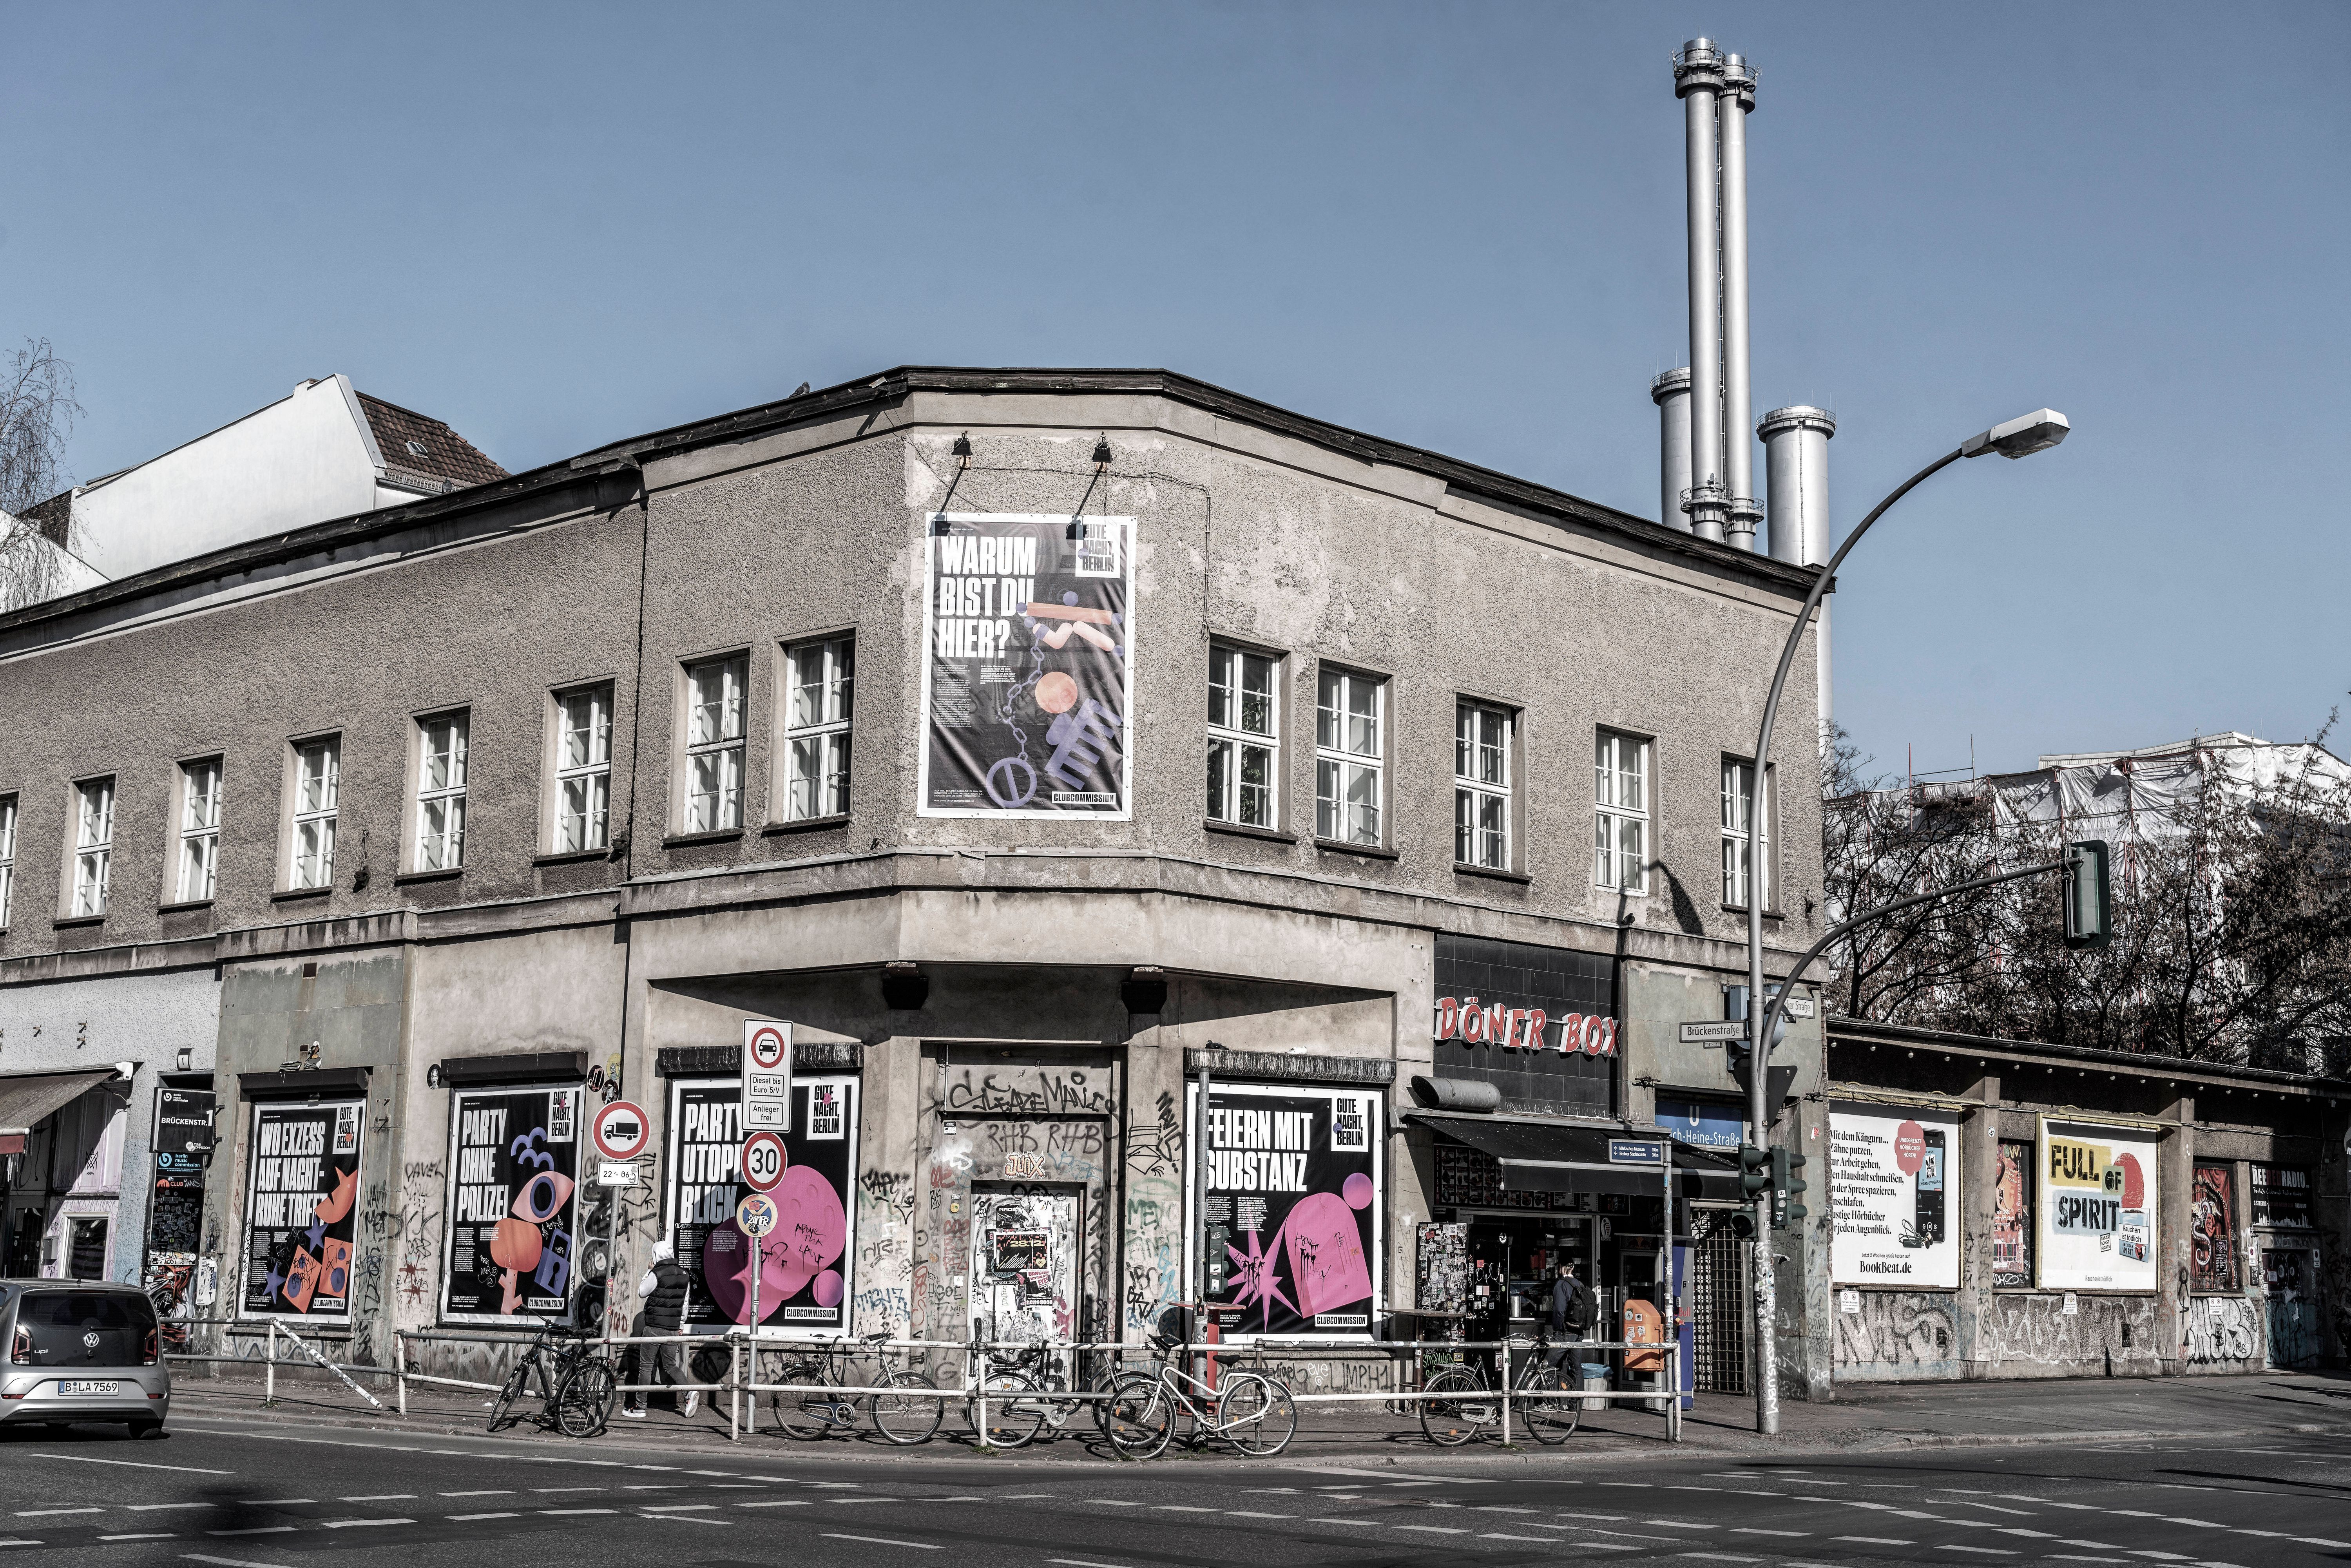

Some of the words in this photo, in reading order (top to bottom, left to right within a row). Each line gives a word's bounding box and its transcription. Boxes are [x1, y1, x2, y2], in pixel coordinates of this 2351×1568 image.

[1084, 524, 1106, 539] GUTE
[940, 536, 1036, 575] WARUM
[1083, 540, 1114, 557] NACHT,
[1082, 556, 1114, 572] BERLIN
[940, 577, 996, 616] BIST
[1001, 578, 1034, 617] DU
[938, 619, 1010, 658] HIER?
[1053, 793, 1114, 803] CLUBCOMMISSION
[1795, 1001, 1810, 1014] Straße
[1435, 996, 1546, 1050] DÖNER
[1559, 1013, 1623, 1057] BOX
[1687, 1024, 1740, 1036] Brückenstraße
[181, 1057, 184, 1065] 1
[553, 1091, 567, 1105] GUTE
[815, 1085, 834, 1100] GUTE
[340, 1107, 352, 1120] GUTE
[552, 1106, 570, 1121] NACHT,
[753, 1105, 779, 1113] Anlieger
[813, 1102, 839, 1117] NACHT,
[1337, 1098, 1356, 1114] GUTE
[161, 1117, 208, 1126] BRÜCKENSTR.
[206, 1110, 213, 1126] 1
[685, 1103, 743, 1141] PARTY
[1337, 1114, 1363, 1131] NACHT,
[1689, 1105, 1699, 1126] U
[338, 1121, 355, 1134] NACHT,
[462, 1109, 507, 1145] PARTY
[551, 1122, 570, 1136] BERLIN
[813, 1118, 839, 1133] BERLIN
[1275, 1111, 1313, 1151] MIT
[261, 1123, 281, 1155] WO
[281, 1121, 326, 1155] EXZESS
[1337, 1130, 1363, 1146] BERLIN
[1830, 1130, 1840, 1140] Mit
[1842, 1131, 1855, 1141] dem
[1856, 1132, 1882, 1145] Känguru
[1830, 1143, 1848, 1153] Zähne
[1849, 1146, 1873, 1157] putzen,
[460, 1147, 496, 1183] OHNE
[752, 1148, 777, 1175] 30
[1840, 1157, 1860, 1168] Arbeit
[1861, 1158, 1880, 1171] gehen,
[2051, 1144, 2099, 1181] FULL
[257, 1158, 281, 1191] AUF
[281, 1157, 324, 1191] NACHT-
[1208, 1150, 1308, 1192] SUBSTANZ
[1842, 1170, 1869, 1181] Haushalt
[1869, 1173, 1904, 1184] schmeißen,
[2105, 1170, 2121, 1191] OF
[1837, 1182, 1847, 1192] der
[1848, 1183, 1865, 1196] Spree
[1866, 1186, 1896, 1198] spazieren,
[457, 1185, 509, 1221] POLIZEI
[681, 1185, 738, 1224] BLICK
[1833, 1196, 1864, 1207] nschlafen.
[255, 1193, 286, 1226] RUHE
[1833, 1209, 1851, 1222] ustige
[1852, 1210, 1886, 1221] Hörbücher
[2058, 1196, 2119, 1231] SPIRIT
[1837, 1222, 1855, 1235] jeden
[1855, 1224, 1891, 1236] Augenblick.
[2127, 1234, 2141, 1242] tödlich
[2122, 1247, 2133, 1255] SPIRIT
[1860, 1261, 1912, 1273] BookBeat.de
[314, 1299, 344, 1307] CLUBCOMMISSION
[529, 1298, 563, 1308] CLUBCOMMISSION
[787, 1308, 836, 1318] CLUBCOMMISSION
[1679, 1307, 1691, 1317] Bull
[1317, 1316, 1366, 1325] CLUBCOMMISSION
[65, 1383, 71, 1392] B
[79, 1383, 91, 1392] LA
[94, 1382, 117, 1392] 7569
